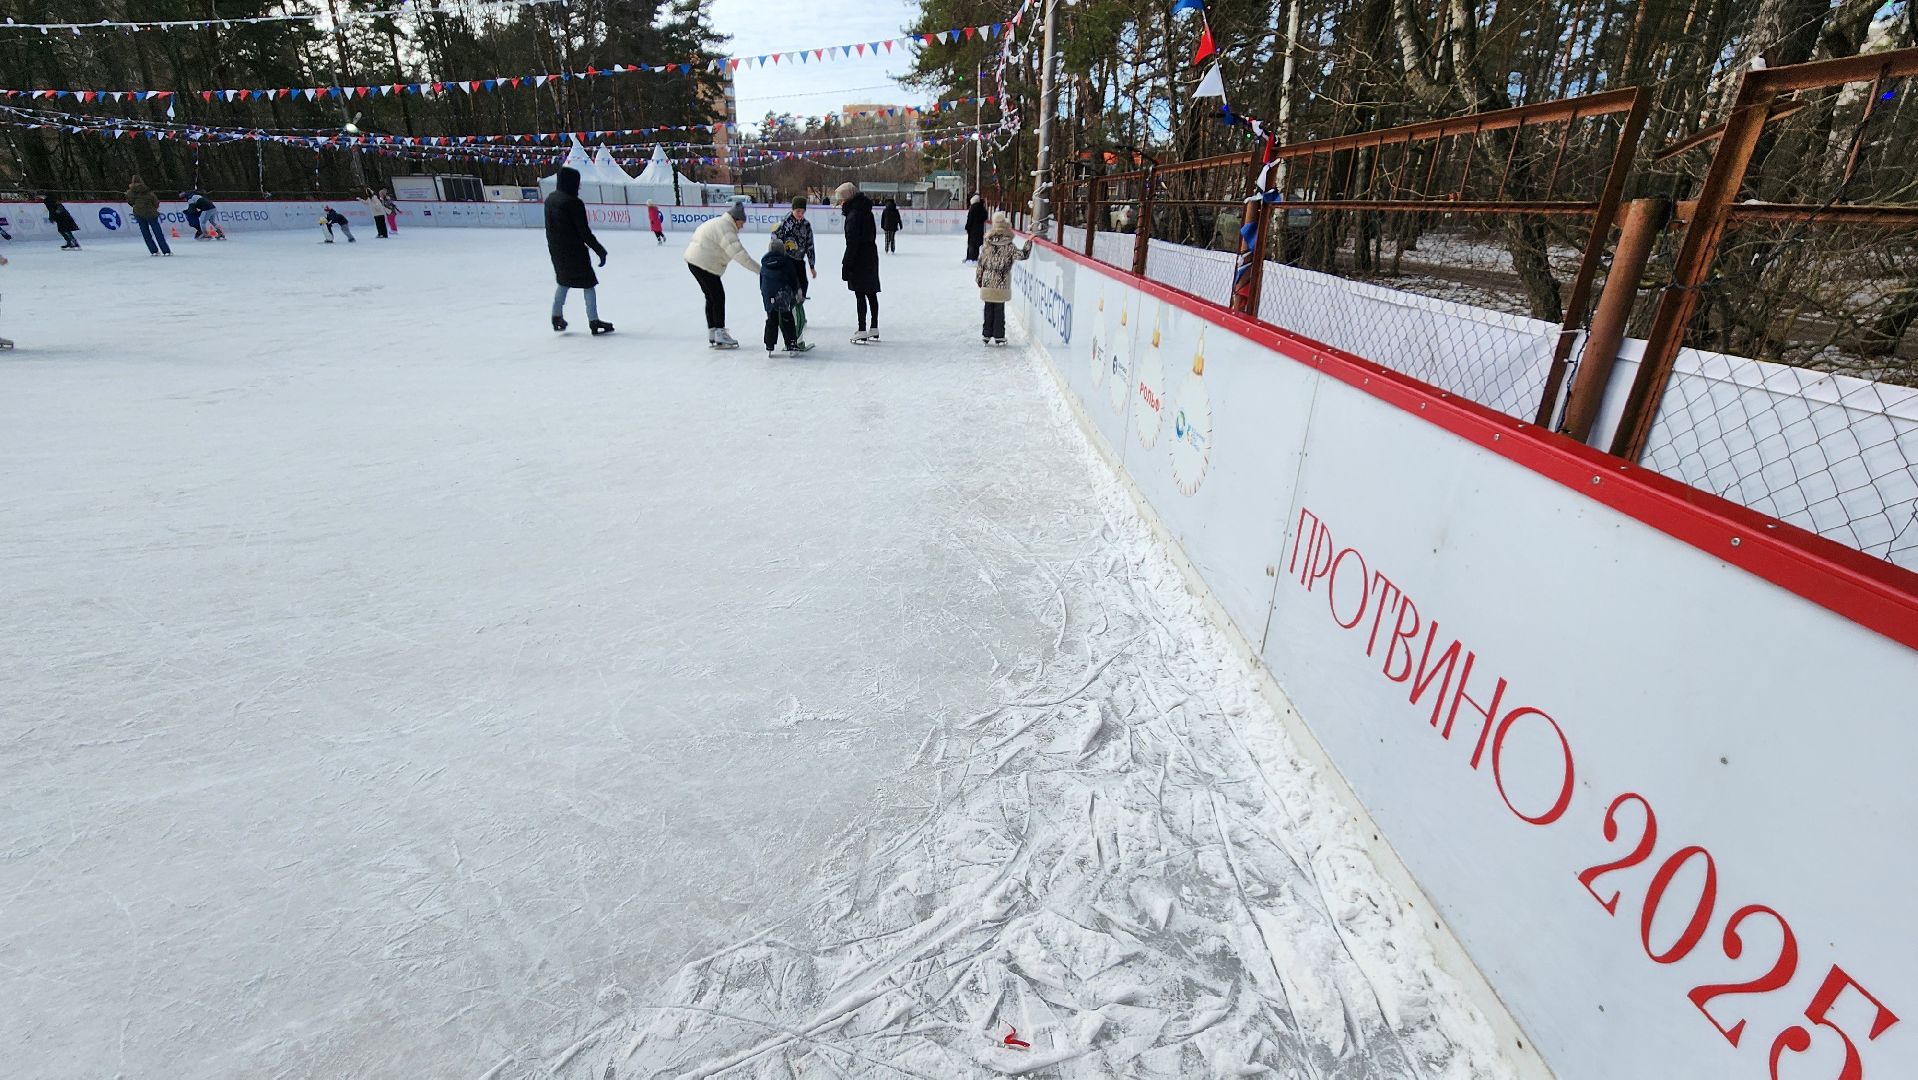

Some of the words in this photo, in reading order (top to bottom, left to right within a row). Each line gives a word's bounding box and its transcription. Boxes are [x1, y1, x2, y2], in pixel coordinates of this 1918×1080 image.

[1140, 381, 1160, 412] РОЛЬФ
[1289, 507, 1575, 825] ПРОТВИНО
[1577, 792, 1900, 1080] 2025
